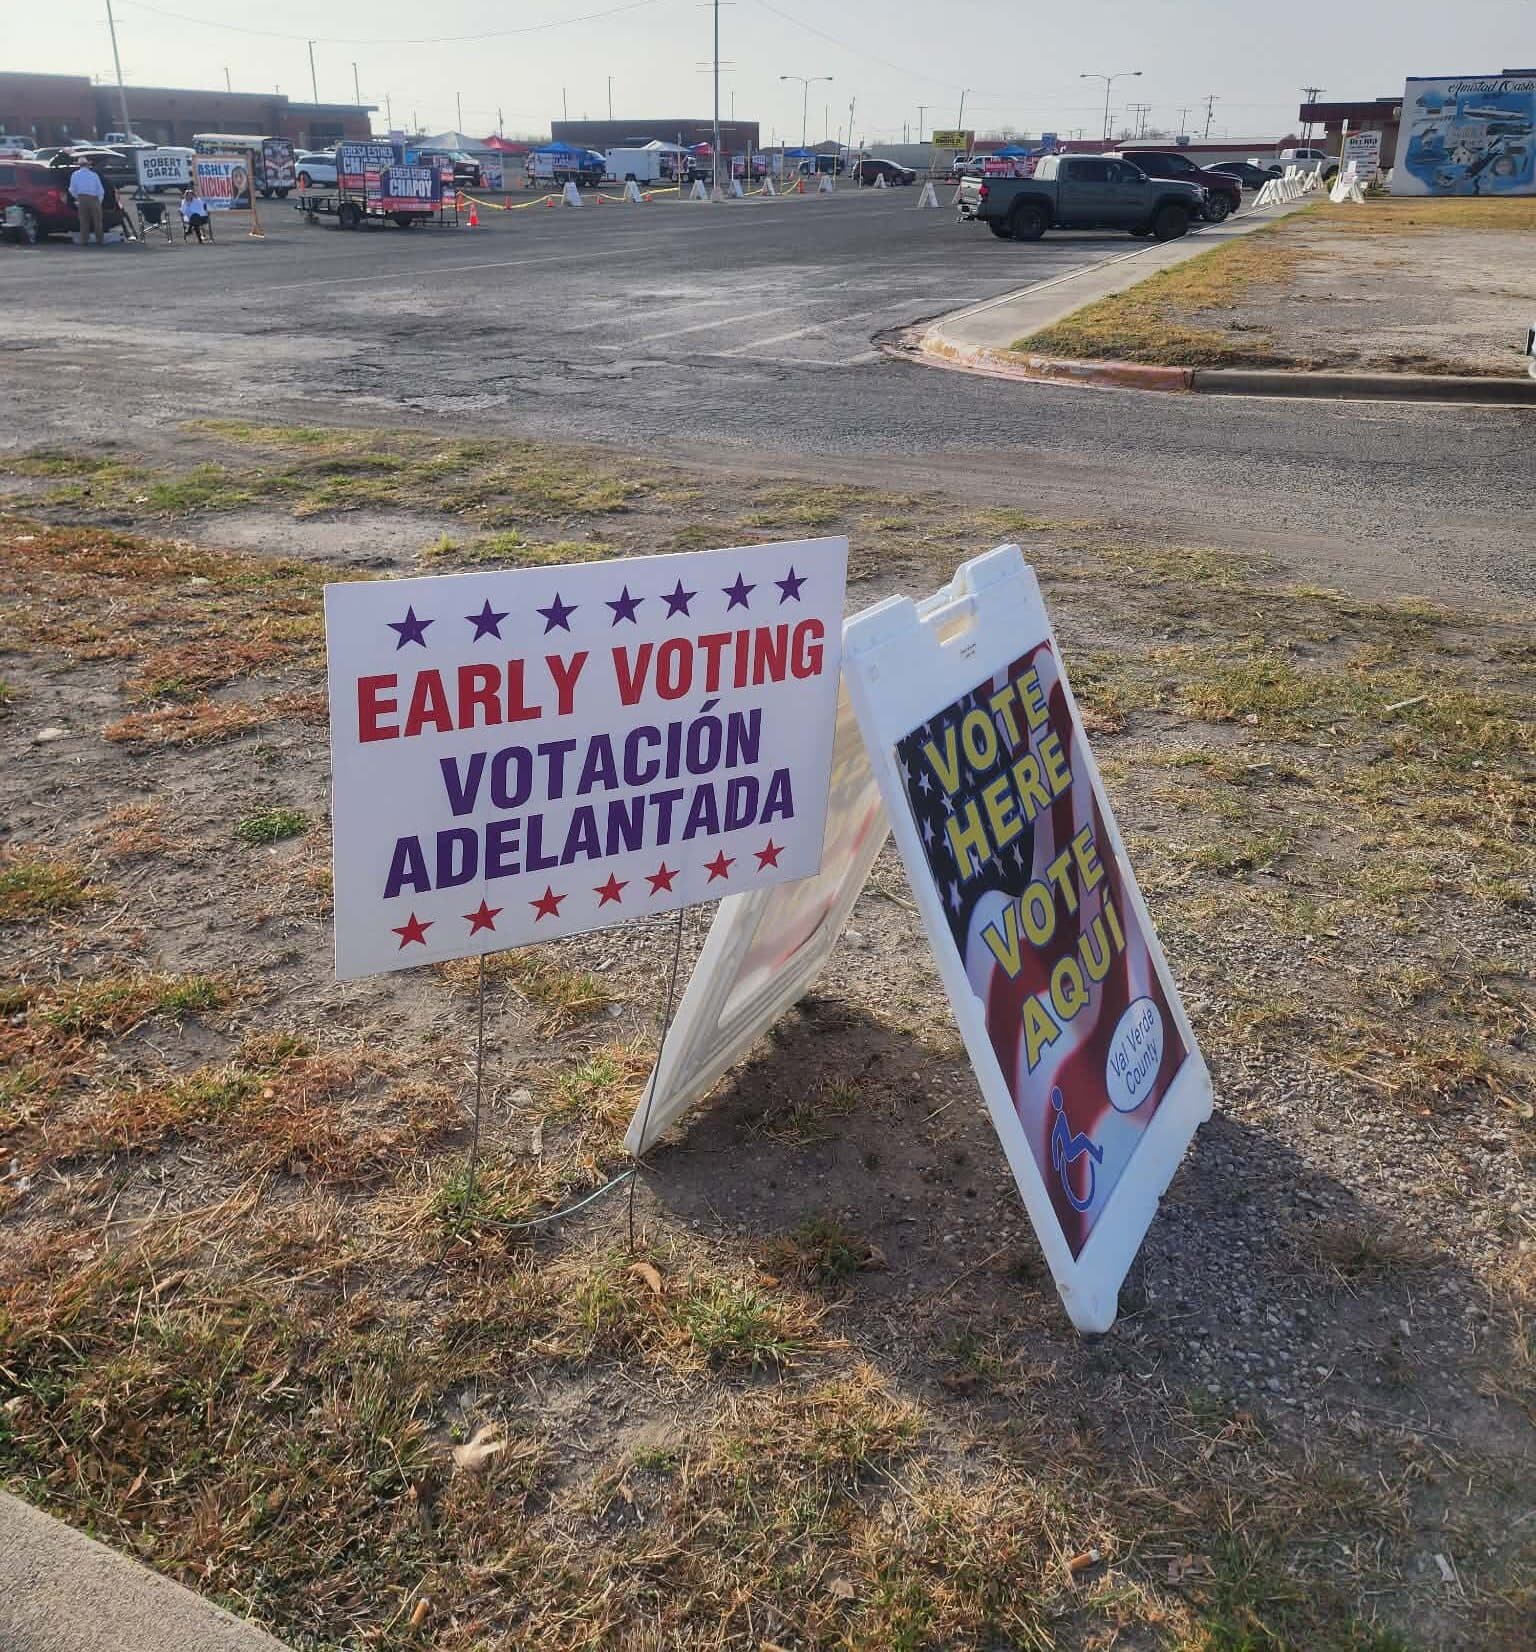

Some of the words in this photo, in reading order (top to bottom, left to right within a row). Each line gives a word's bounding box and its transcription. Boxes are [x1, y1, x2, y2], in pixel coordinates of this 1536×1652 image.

[143, 156, 183, 169] ROBERT
[146, 167, 181, 179] GARZA
[197, 163, 230, 176] ASHLY
[389, 179, 433, 197] CHAPOY
[357, 651, 589, 743] EARLY
[612, 618, 825, 706] VOTING
[923, 666, 1050, 796] VOTE
[440, 698, 762, 817] VOTACIÓN
[945, 731, 1073, 880] HERE
[383, 768, 794, 899] ADELANTADA
[980, 824, 1105, 980] VOTE
[1022, 887, 1127, 1075] AQUÍ
[1110, 1042, 1130, 1077] Val
[1126, 1008, 1154, 1052] Verde
[1126, 1038, 1160, 1094] County
